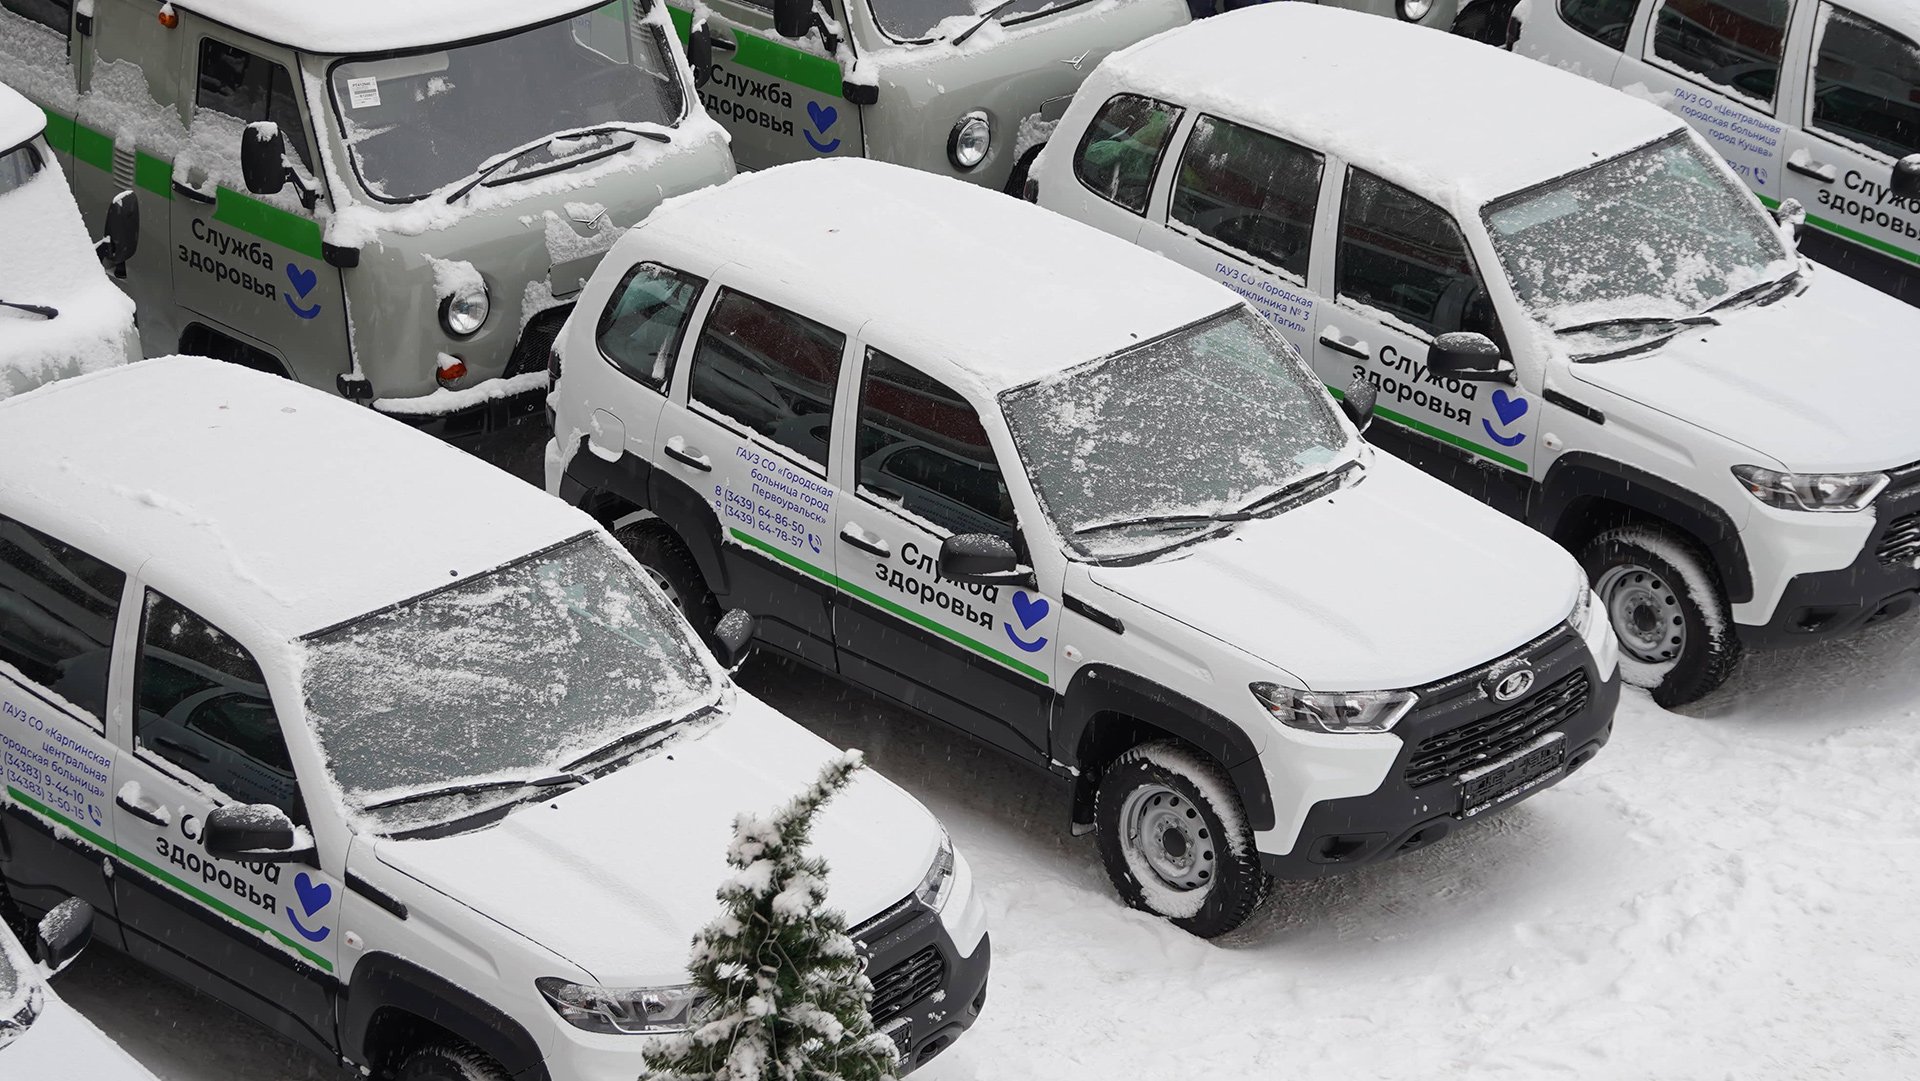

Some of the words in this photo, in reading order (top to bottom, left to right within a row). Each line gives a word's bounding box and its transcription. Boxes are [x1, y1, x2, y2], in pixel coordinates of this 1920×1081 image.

[710, 64, 792, 109] Служба
[1674, 88, 1697, 103] ГАУЗ
[1698, 97, 1713, 109] СО
[1714, 105, 1782, 135] «Центральная
[1681, 105, 1729, 128] городская
[1730, 122, 1777, 147] больница
[1708, 128, 1737, 146] город
[1738, 139, 1773, 158] Кушва»
[1818, 189, 1920, 241] здоровь
[191, 218, 274, 271] Служба
[179, 244, 277, 301] здоровья
[1215, 262, 1239, 279] ГАУЗ
[1240, 273, 1256, 285] СО
[1257, 281, 1314, 309] «Городская
[1273, 312, 1306, 333] Тагил»
[1303, 310, 1310, 321] 3
[1352, 364, 1472, 426] здоровья
[735, 446, 760, 465] ГАУЗ
[761, 458, 777, 472] СО
[778, 467, 834, 498] «Городская
[750, 468, 798, 498] больница
[799, 494, 830, 513] город
[714, 485, 722, 496] 8
[724, 488, 755, 514] (3439)
[757, 505, 805, 535] 64-86-50
[724, 504, 756, 529] (3439)
[758, 520, 804, 549] 64-78-57
[751, 483, 827, 524] Первоуральск»
[875, 562, 994, 631] здоровья
[2, 701, 27, 722] ГАУЗ
[28, 716, 43, 731] СО
[45, 727, 111, 769] «Карпинская
[4, 752, 42, 784] (34383)
[44, 774, 84, 805] 9-44-10
[42, 742, 107, 785] центральная
[51, 761, 105, 798] больница»
[7, 768, 45, 800] (34383)
[47, 791, 85, 820] 3-50-15
[156, 836, 276, 915] здоровья
